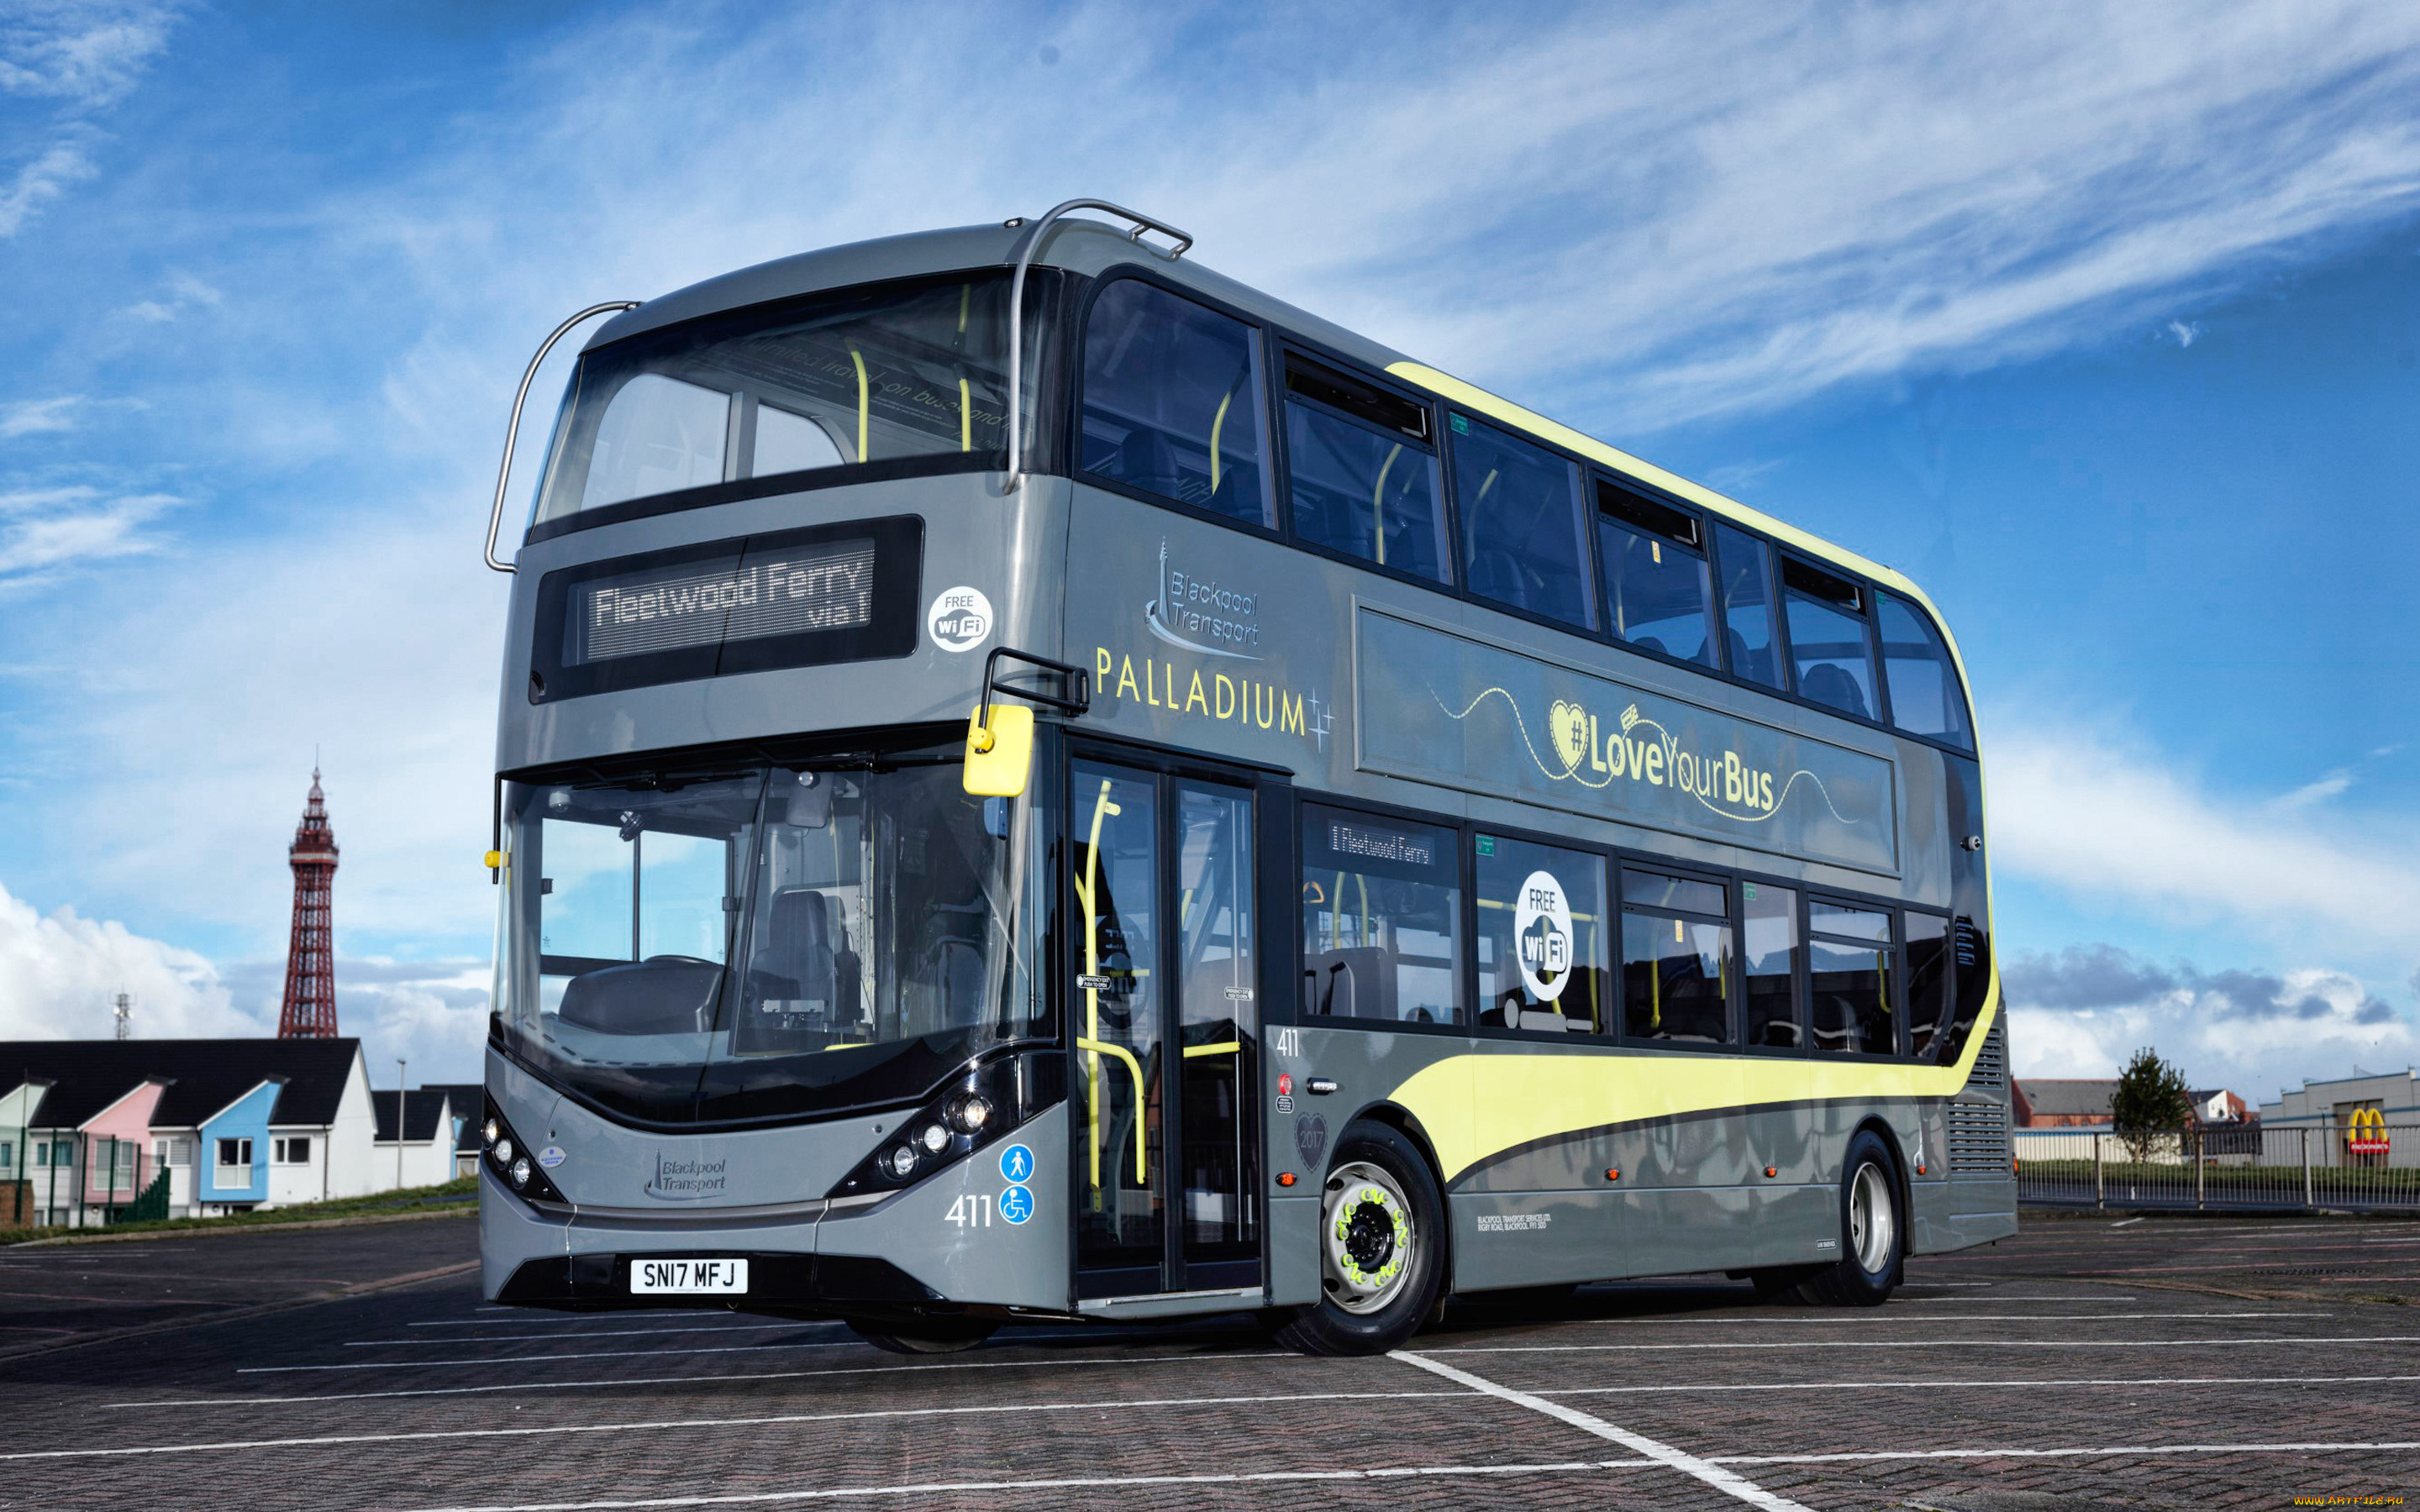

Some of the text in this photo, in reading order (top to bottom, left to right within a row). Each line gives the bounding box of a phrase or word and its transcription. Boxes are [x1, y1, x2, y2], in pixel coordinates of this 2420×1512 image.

[885, 382, 912, 396] on
[597, 563, 862, 626] Fleetwood Ferry
[945, 596, 974, 607] FREE
[1171, 571, 1258, 616] Blackpool
[808, 601, 849, 627] via
[1172, 601, 1260, 646] Transport
[1097, 647, 1306, 736] PALLADIUM
[1342, 827, 1396, 859] Fleetwood
[1398, 837, 1428, 864] Ferry
[1529, 888, 1556, 914] FREE
[1276, 1028, 1299, 1057] 411
[1301, 1131, 1324, 1149] 2017
[662, 1159, 726, 1176] Blackpool
[662, 1176, 726, 1193] Transport
[944, 1194, 991, 1227] 411
[644, 1263, 734, 1287] SN17 MFJ
